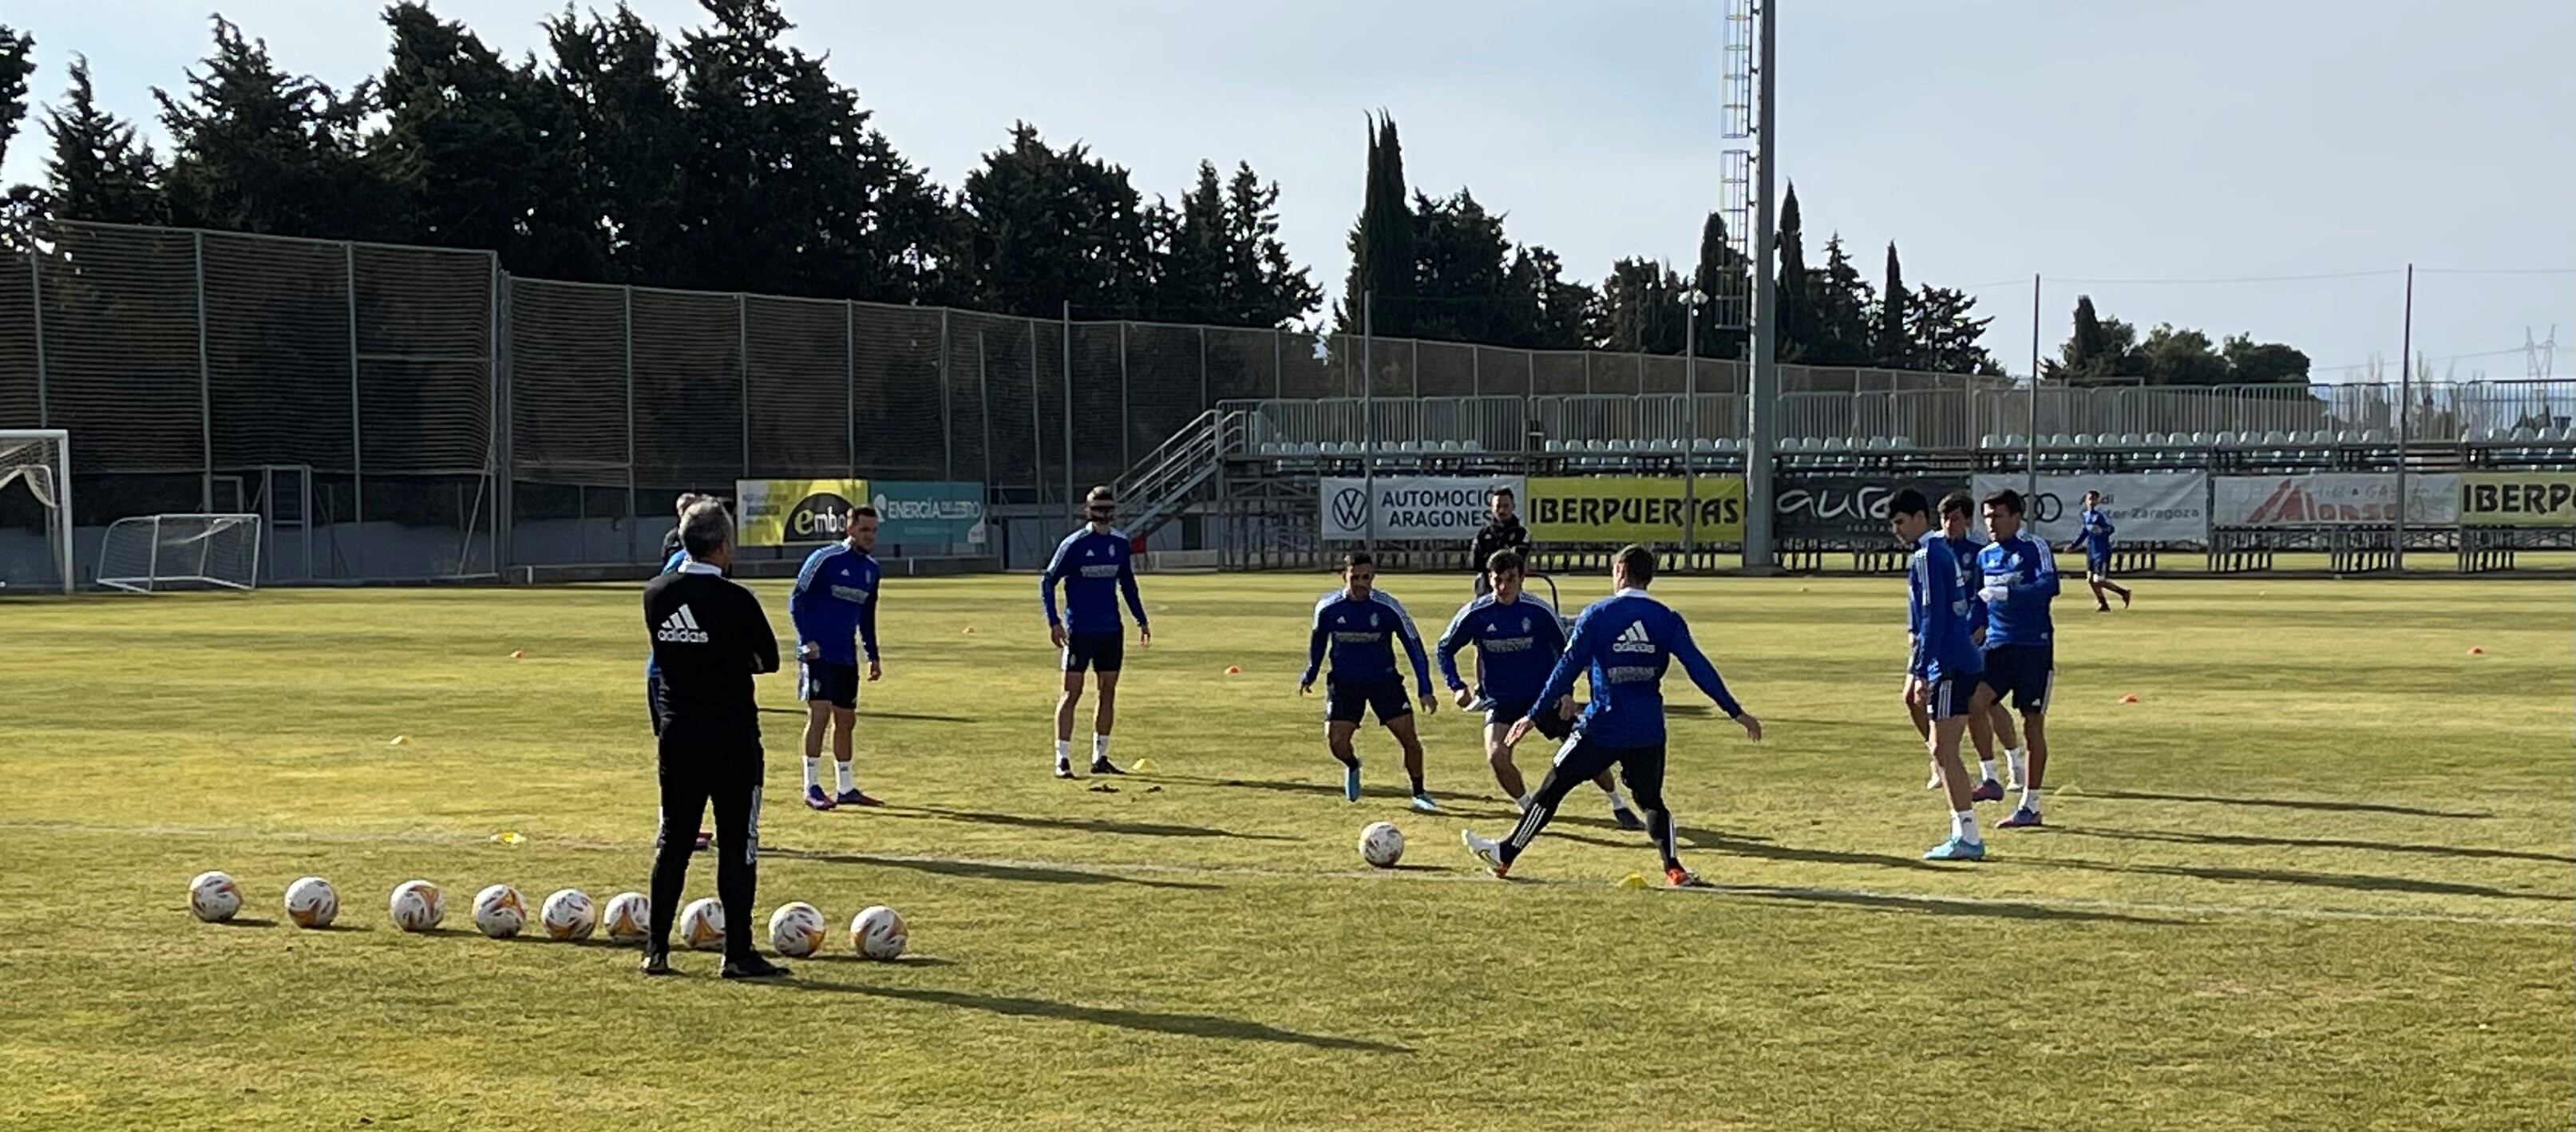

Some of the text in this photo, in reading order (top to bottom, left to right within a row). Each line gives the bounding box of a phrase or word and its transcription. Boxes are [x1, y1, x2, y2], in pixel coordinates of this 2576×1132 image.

[1381, 485, 1493, 507] AUTOMOCIÓ
[2463, 484, 2576, 515] IBERP
[794, 505, 846, 535] embo
[1389, 511, 1492, 528] ARAGONES
[1530, 498, 1739, 527] IBERPUERTAS
[2131, 508, 2199, 520] Zaragoza
[658, 628, 709, 643] adidas
[1612, 642, 1656, 654] adidas
